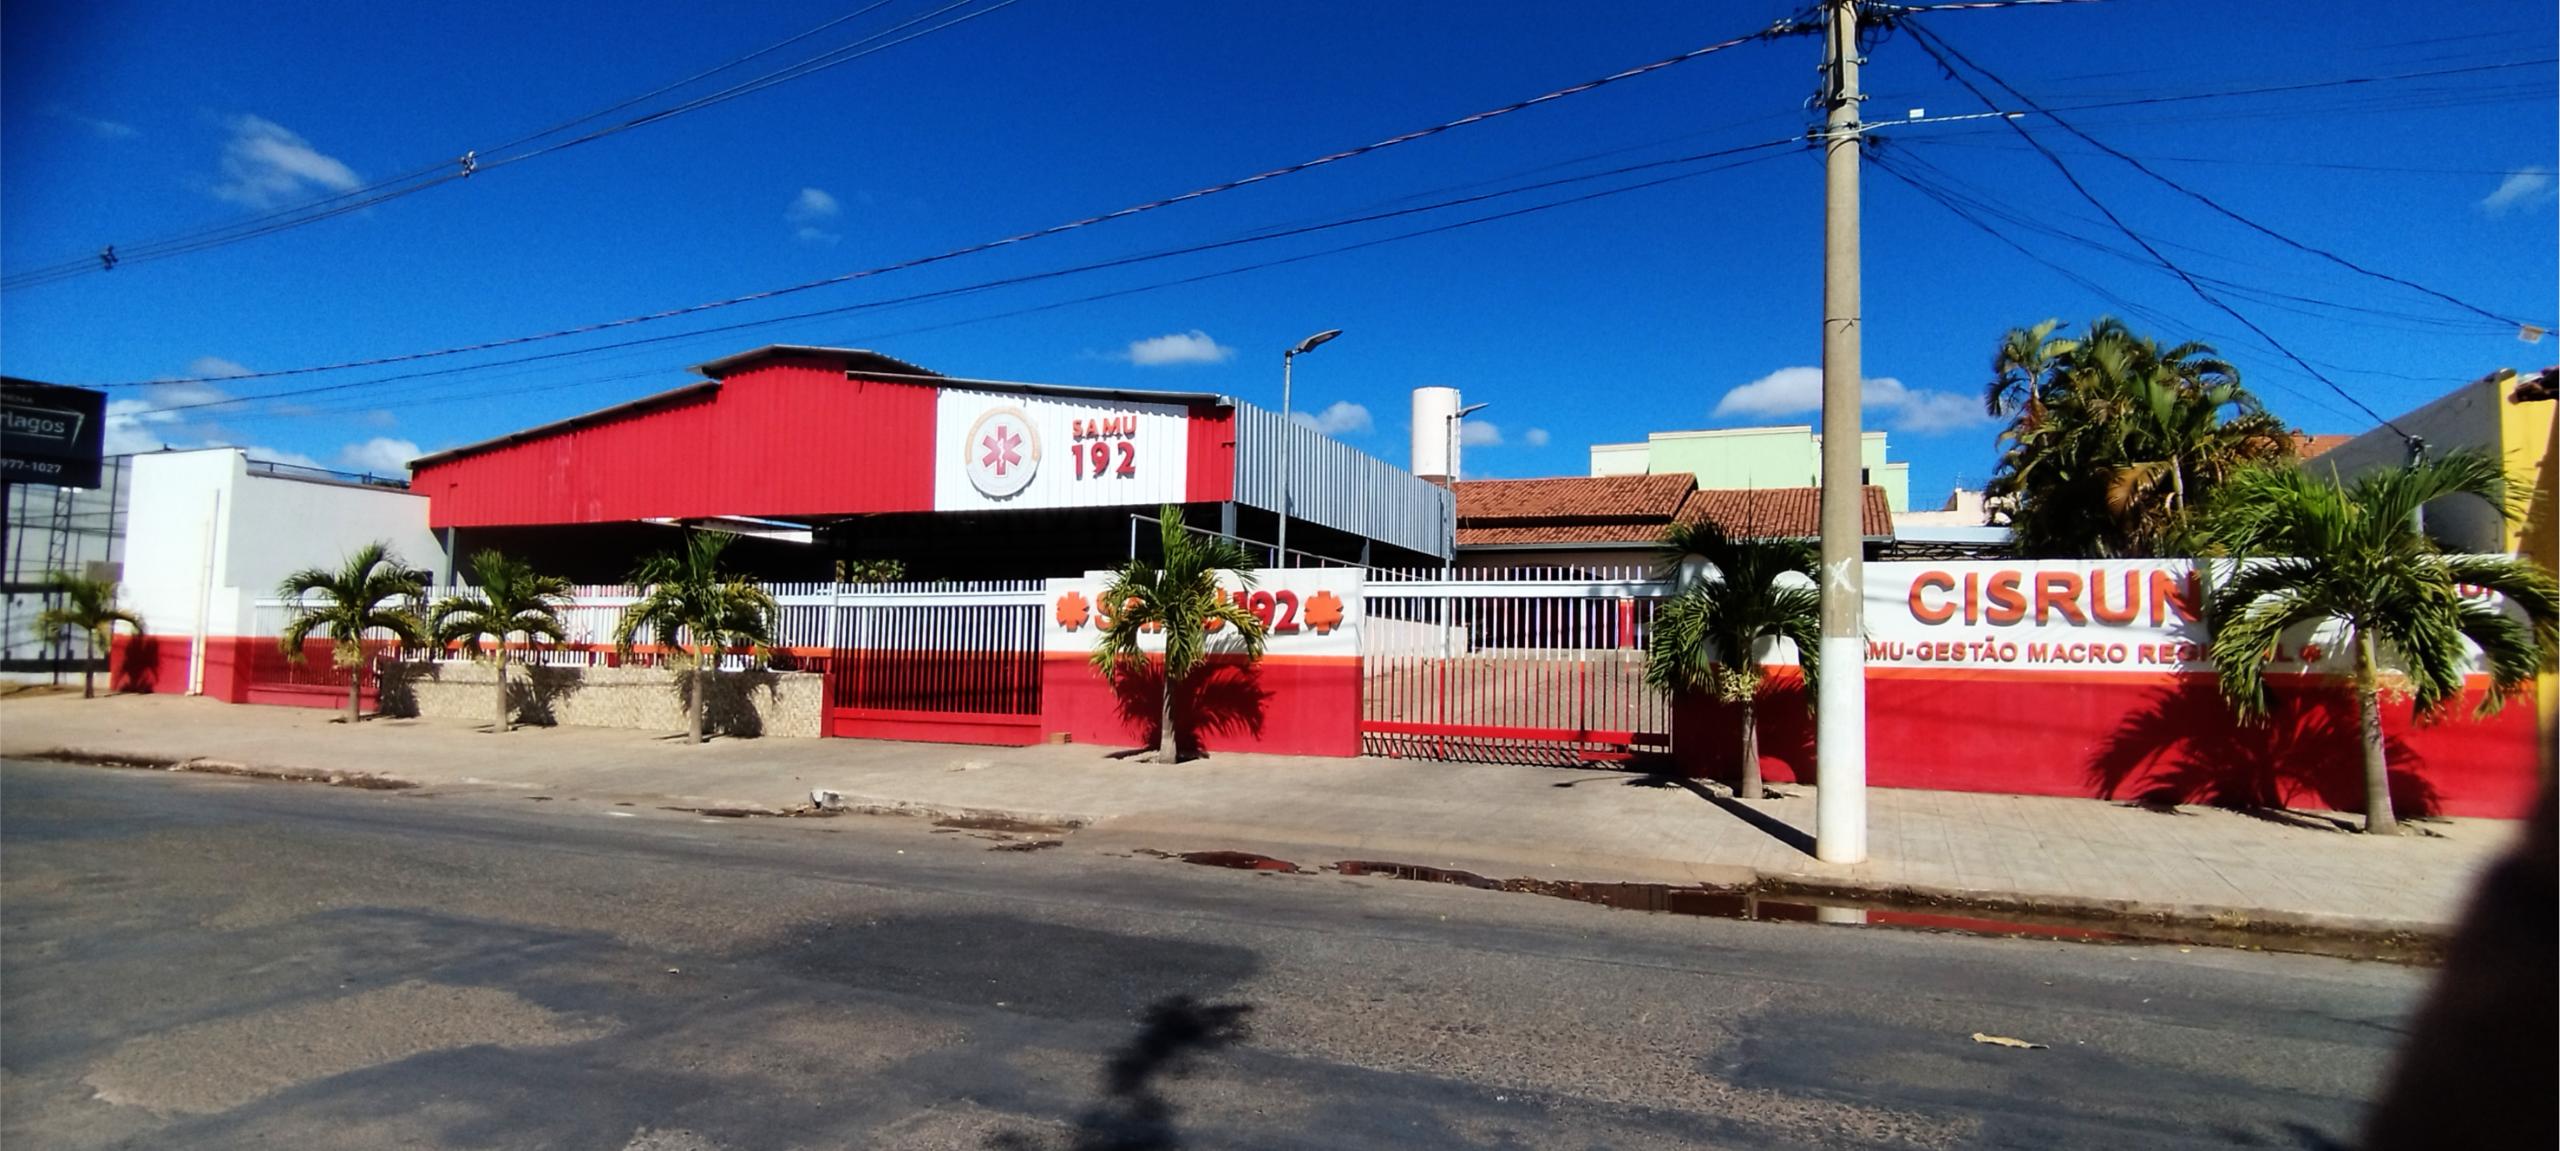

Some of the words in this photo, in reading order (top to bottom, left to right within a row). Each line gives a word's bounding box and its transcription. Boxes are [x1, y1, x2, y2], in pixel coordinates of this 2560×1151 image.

[1072, 415, 1137, 438] SAMU
[1071, 441, 1136, 477] 192
[1908, 569, 2203, 627] CISRUN
[2027, 642, 2128, 664] MACRO
